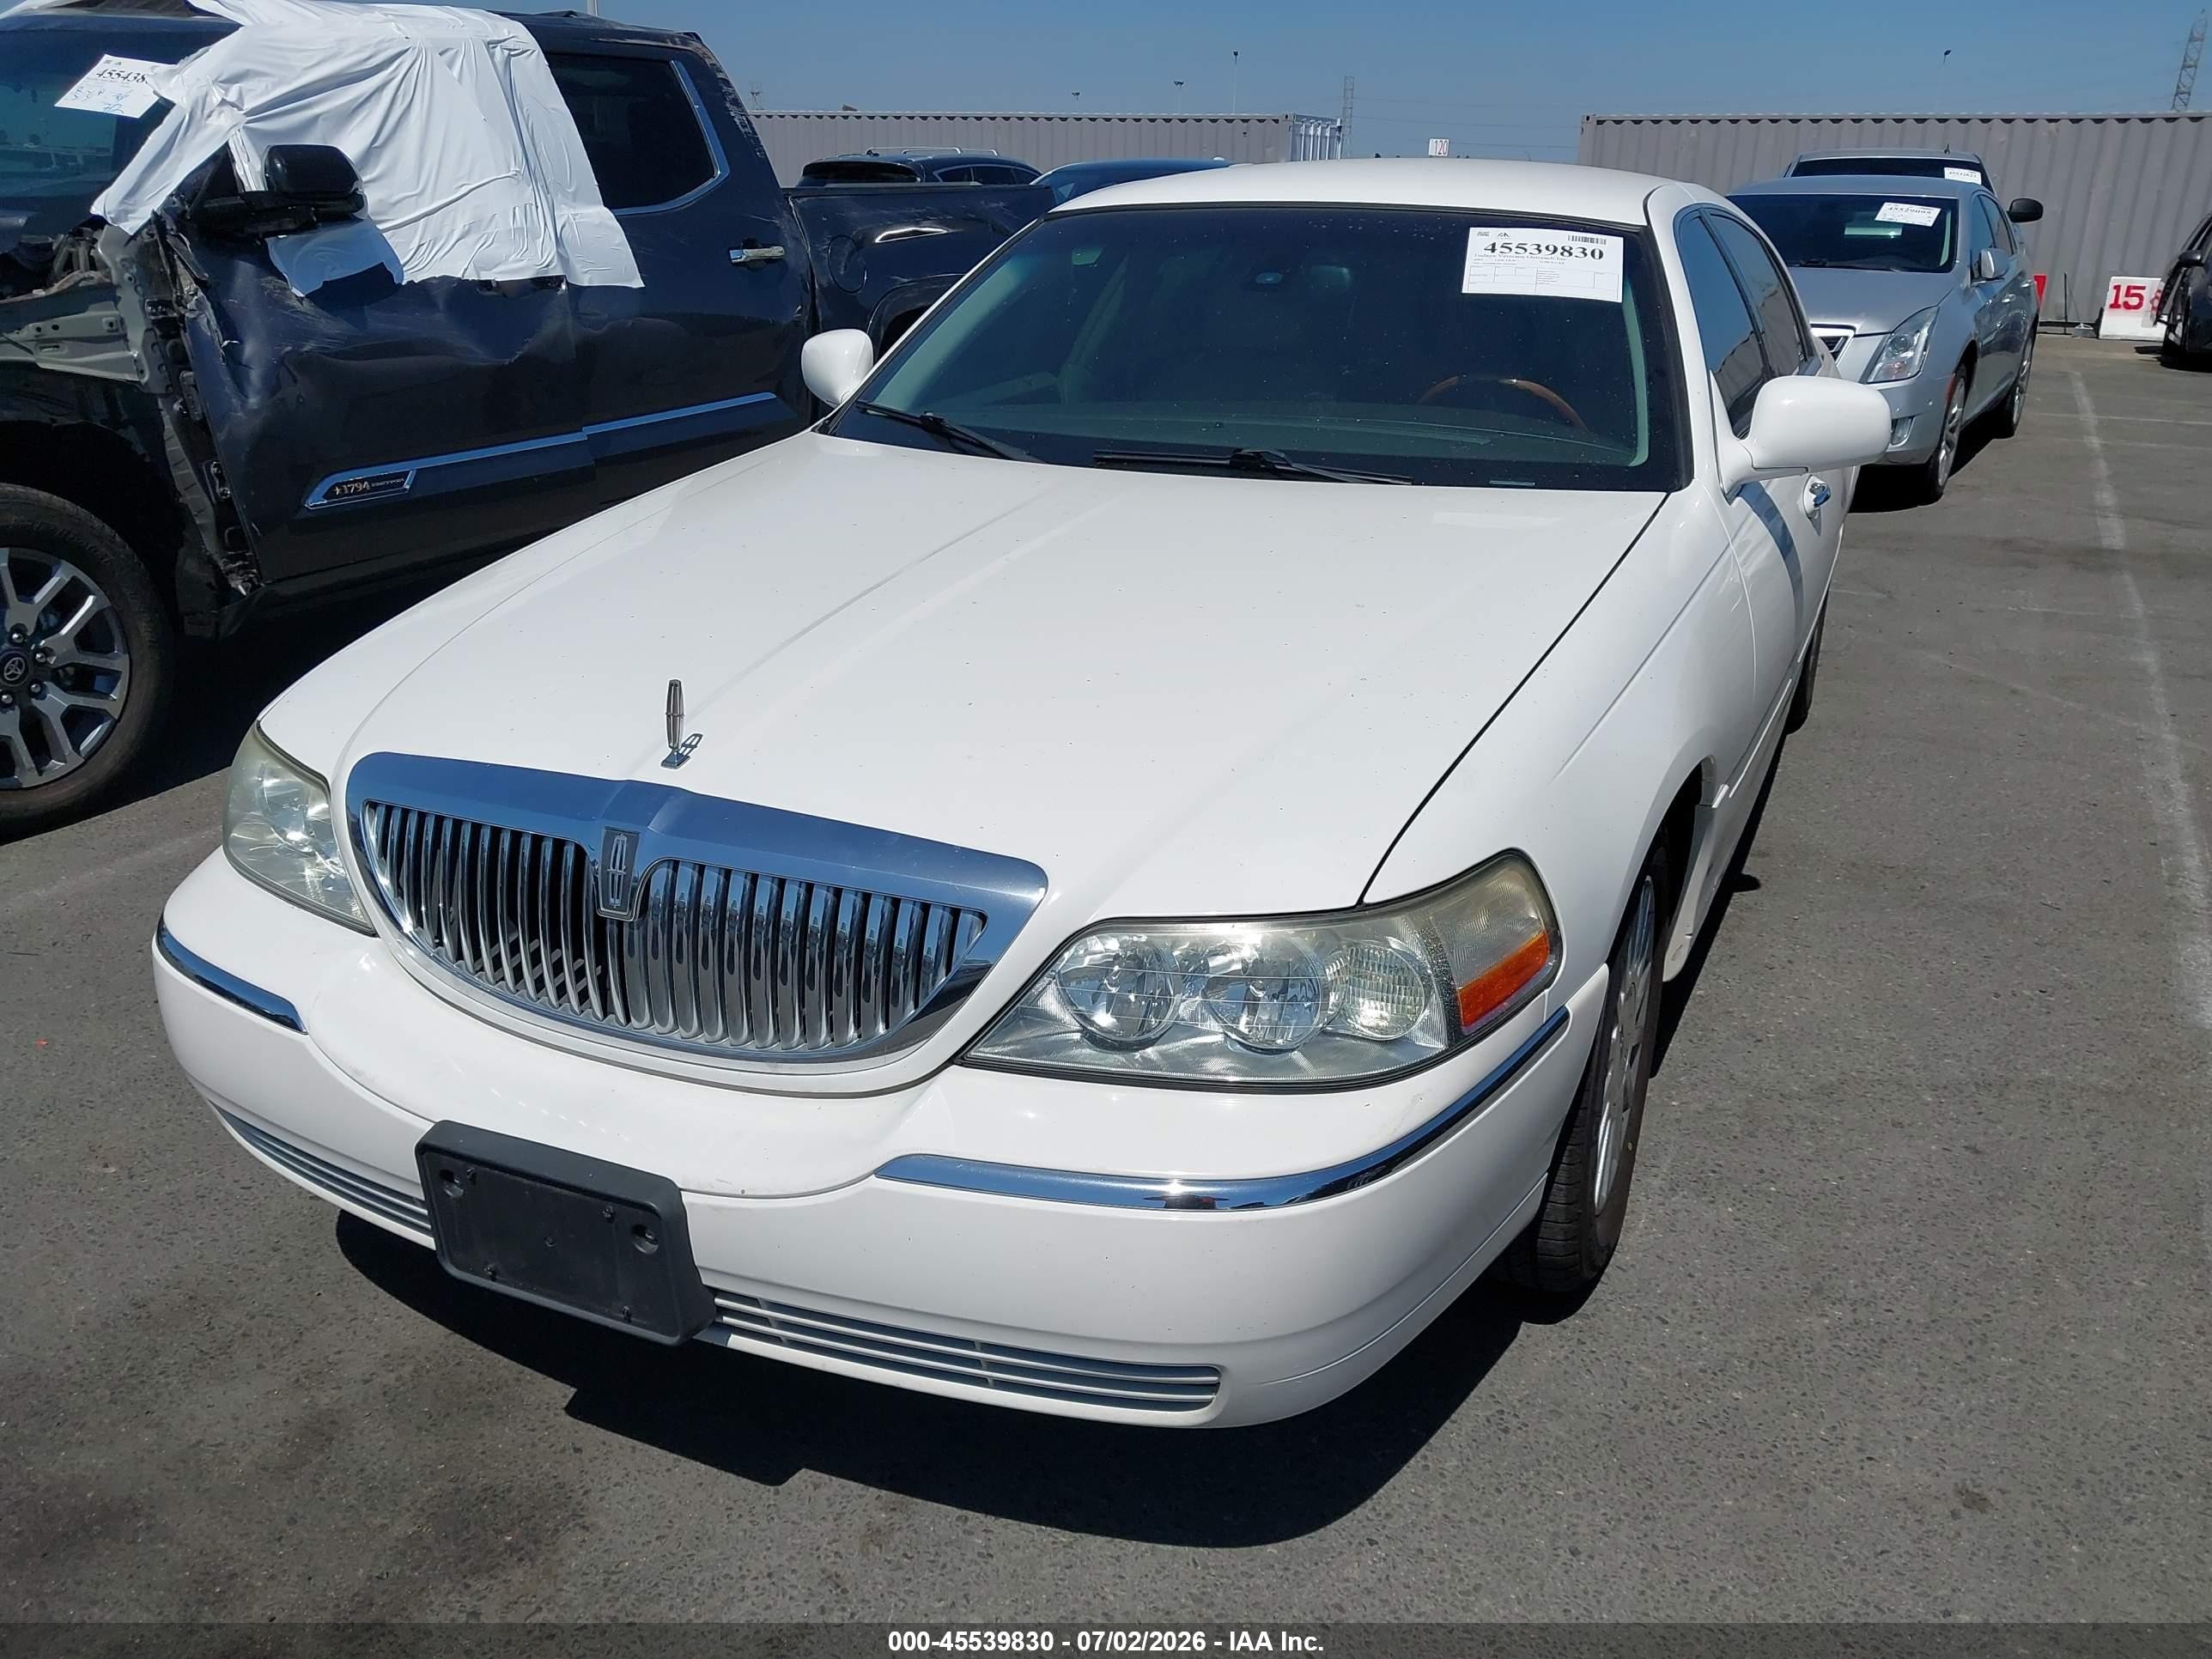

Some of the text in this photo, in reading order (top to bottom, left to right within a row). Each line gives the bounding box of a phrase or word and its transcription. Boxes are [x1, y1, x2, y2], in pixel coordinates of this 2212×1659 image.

[96, 68, 149, 84] 455438
[1483, 241, 1604, 260] 45539830
[342, 481, 370, 494] 1794
